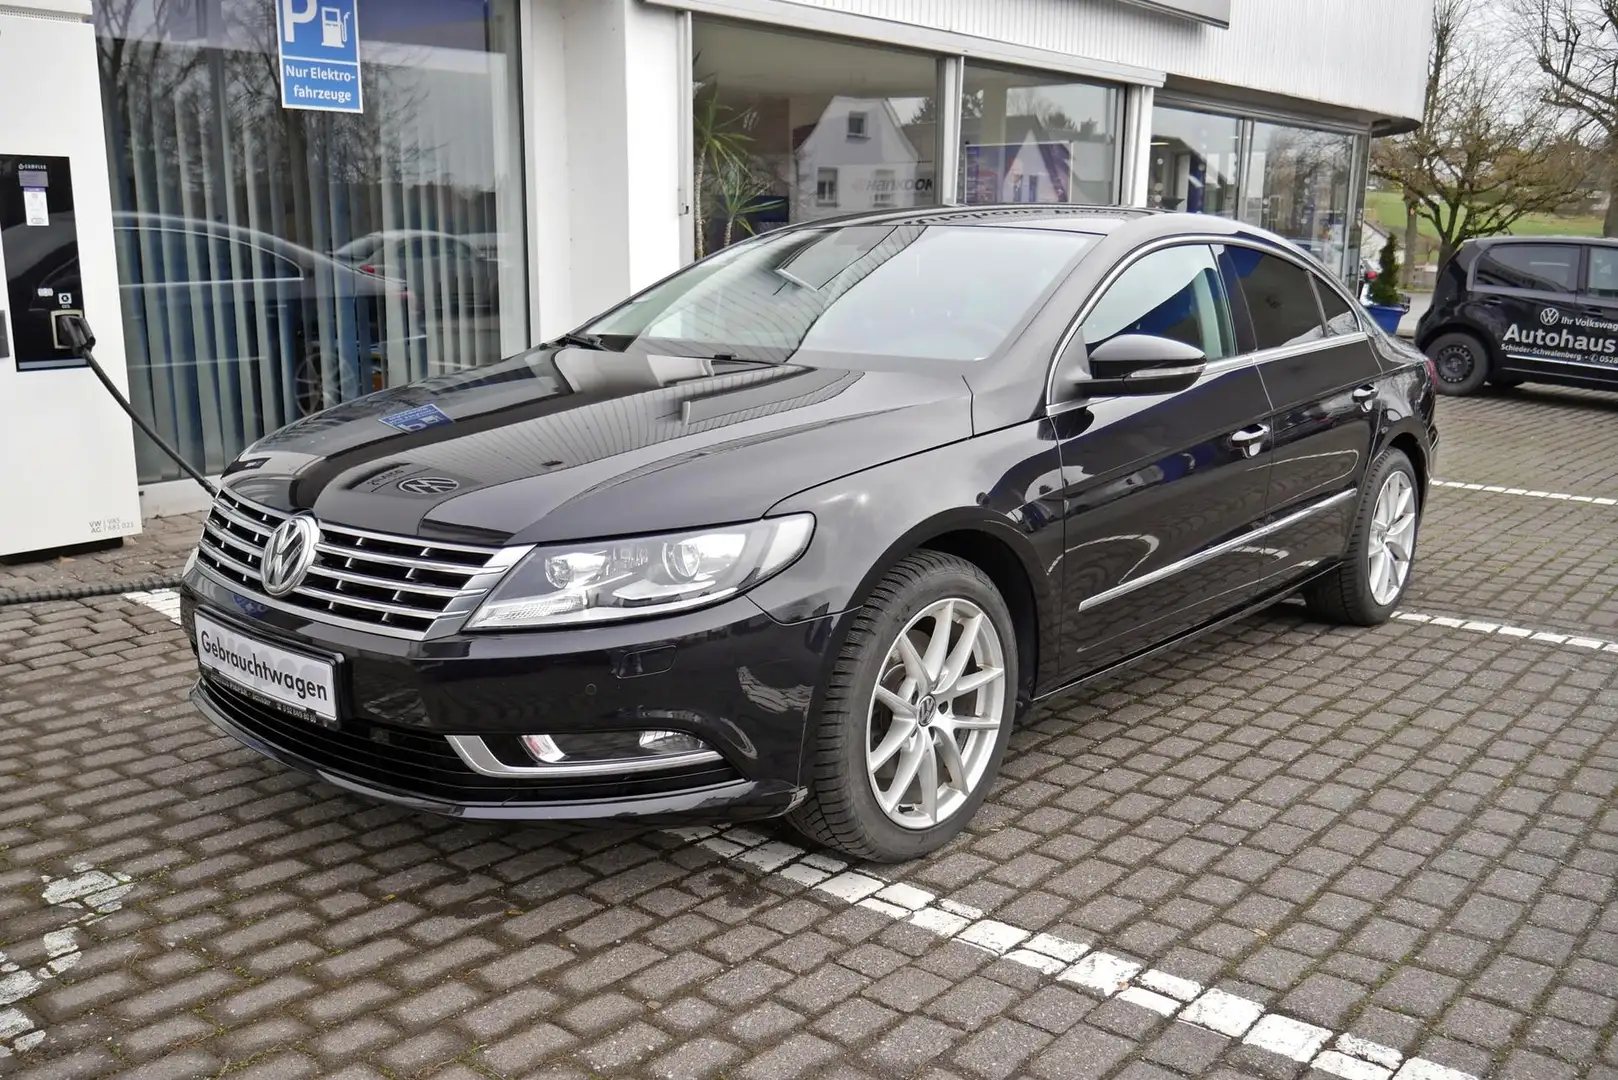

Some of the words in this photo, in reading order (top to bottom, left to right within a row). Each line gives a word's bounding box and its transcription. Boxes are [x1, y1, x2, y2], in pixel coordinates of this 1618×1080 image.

[282, 0, 317, 42] P
[285, 64, 309, 78] Nur
[310, 67, 356, 82] Elektro-
[293, 84, 352, 103] fahrzeuge
[1561, 316, 1574, 326] Ihr
[1502, 323, 1616, 353] Autohaus
[1500, 343, 1582, 361] Schieder-Schwalenberg
[89, 520, 102, 528] VW
[201, 630, 328, 701] Gebrauchtwagen
